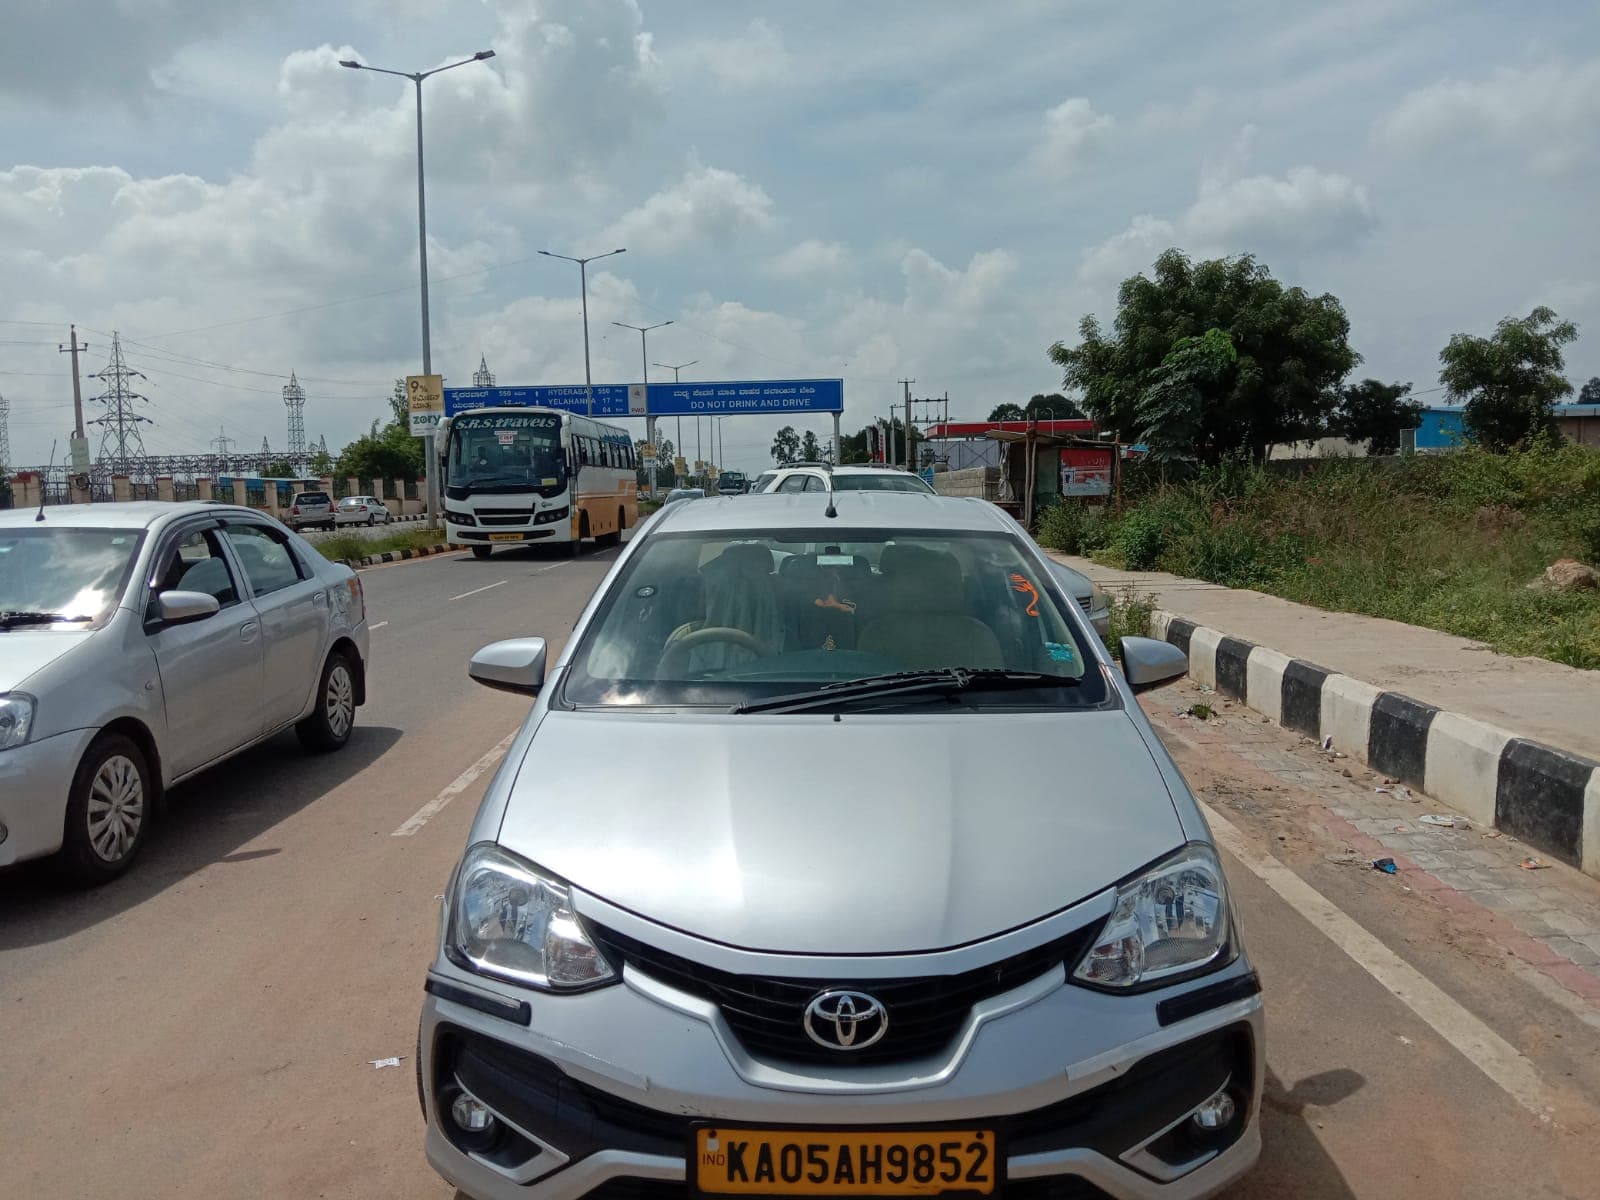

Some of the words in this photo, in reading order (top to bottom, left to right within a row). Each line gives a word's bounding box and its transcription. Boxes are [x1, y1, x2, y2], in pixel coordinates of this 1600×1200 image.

[691, 401, 705, 409] DO
[707, 400, 726, 409] NOT
[729, 399, 758, 408] DRINK
[760, 399, 780, 407] AND
[782, 398, 811, 407] DRIVE
[412, 415, 441, 426] zory
[702, 1153, 725, 1166] IND
[727, 1141, 989, 1185] KA05AH9852
